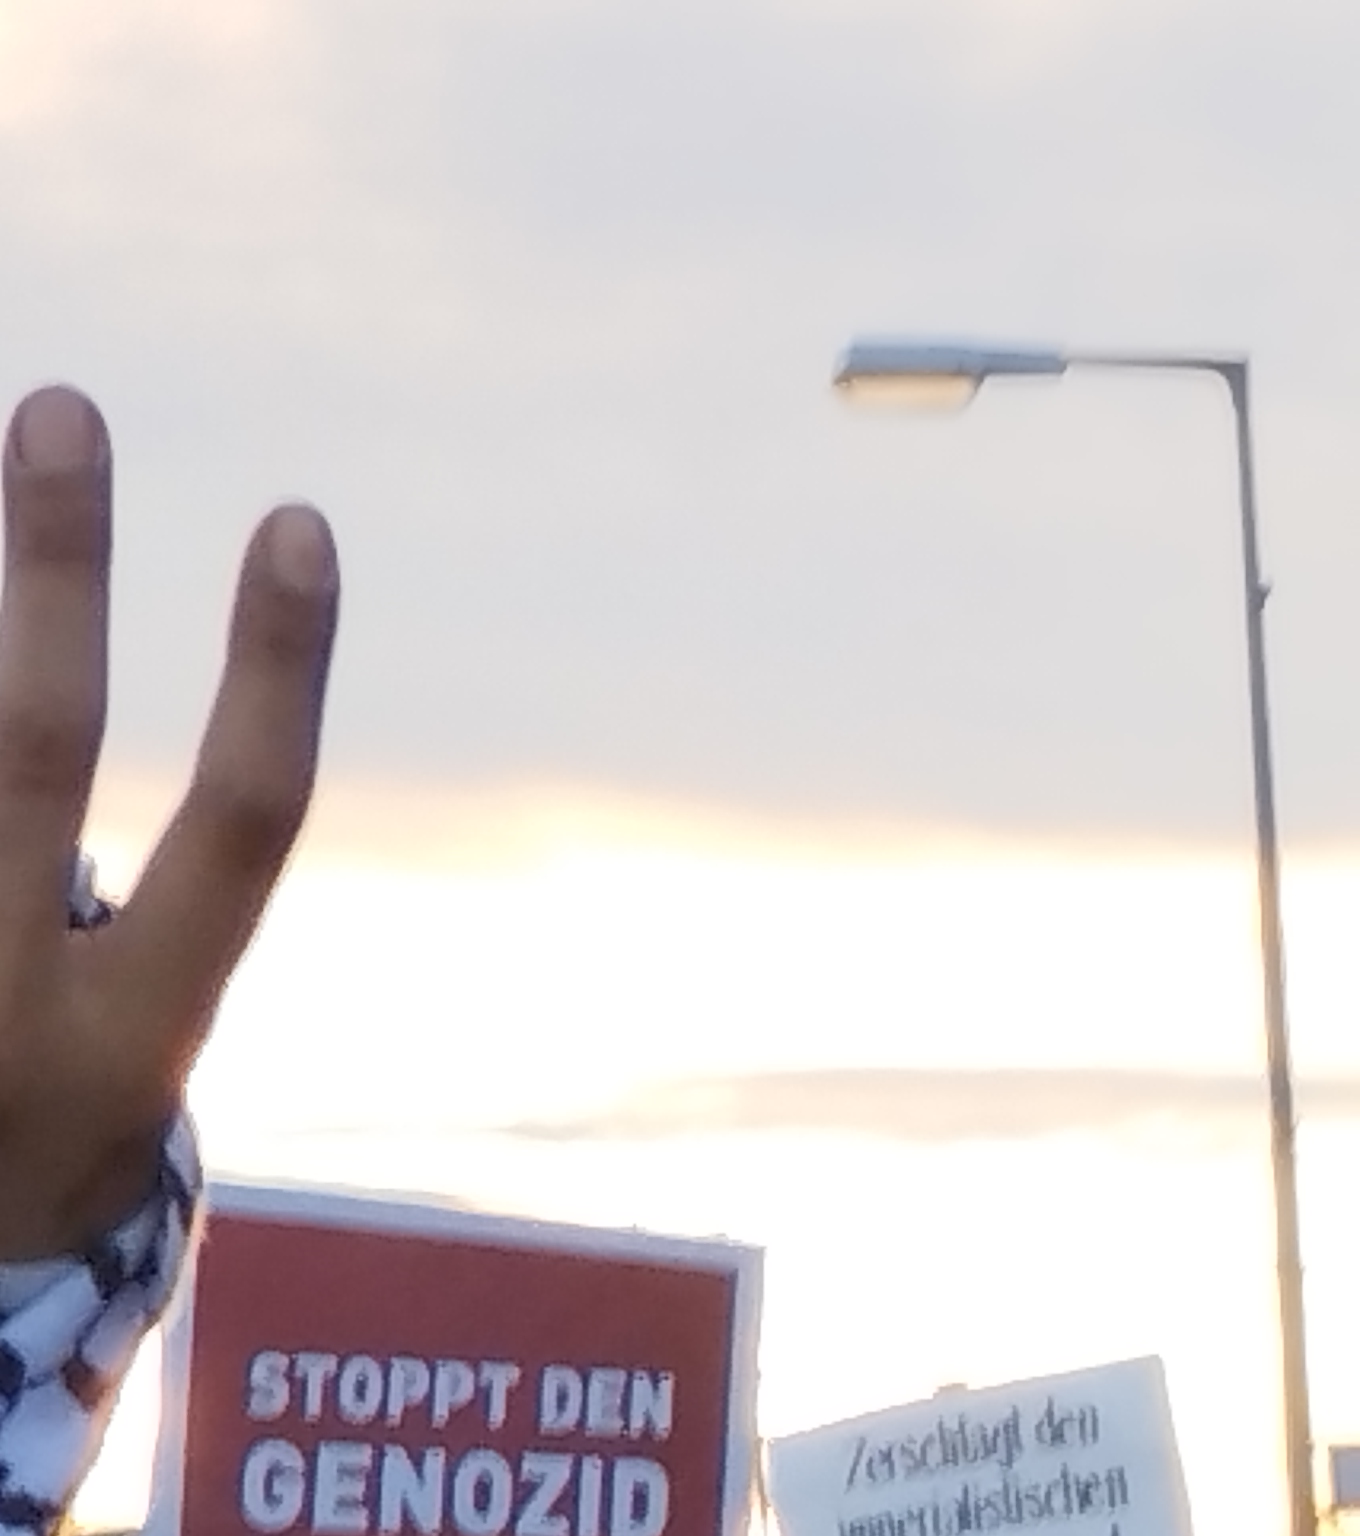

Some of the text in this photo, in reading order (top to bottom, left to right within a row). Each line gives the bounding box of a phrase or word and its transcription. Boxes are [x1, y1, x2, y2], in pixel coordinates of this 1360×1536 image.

[246, 1350, 676, 1441] STOPPT DEN
[1033, 1396, 1099, 1448] den
